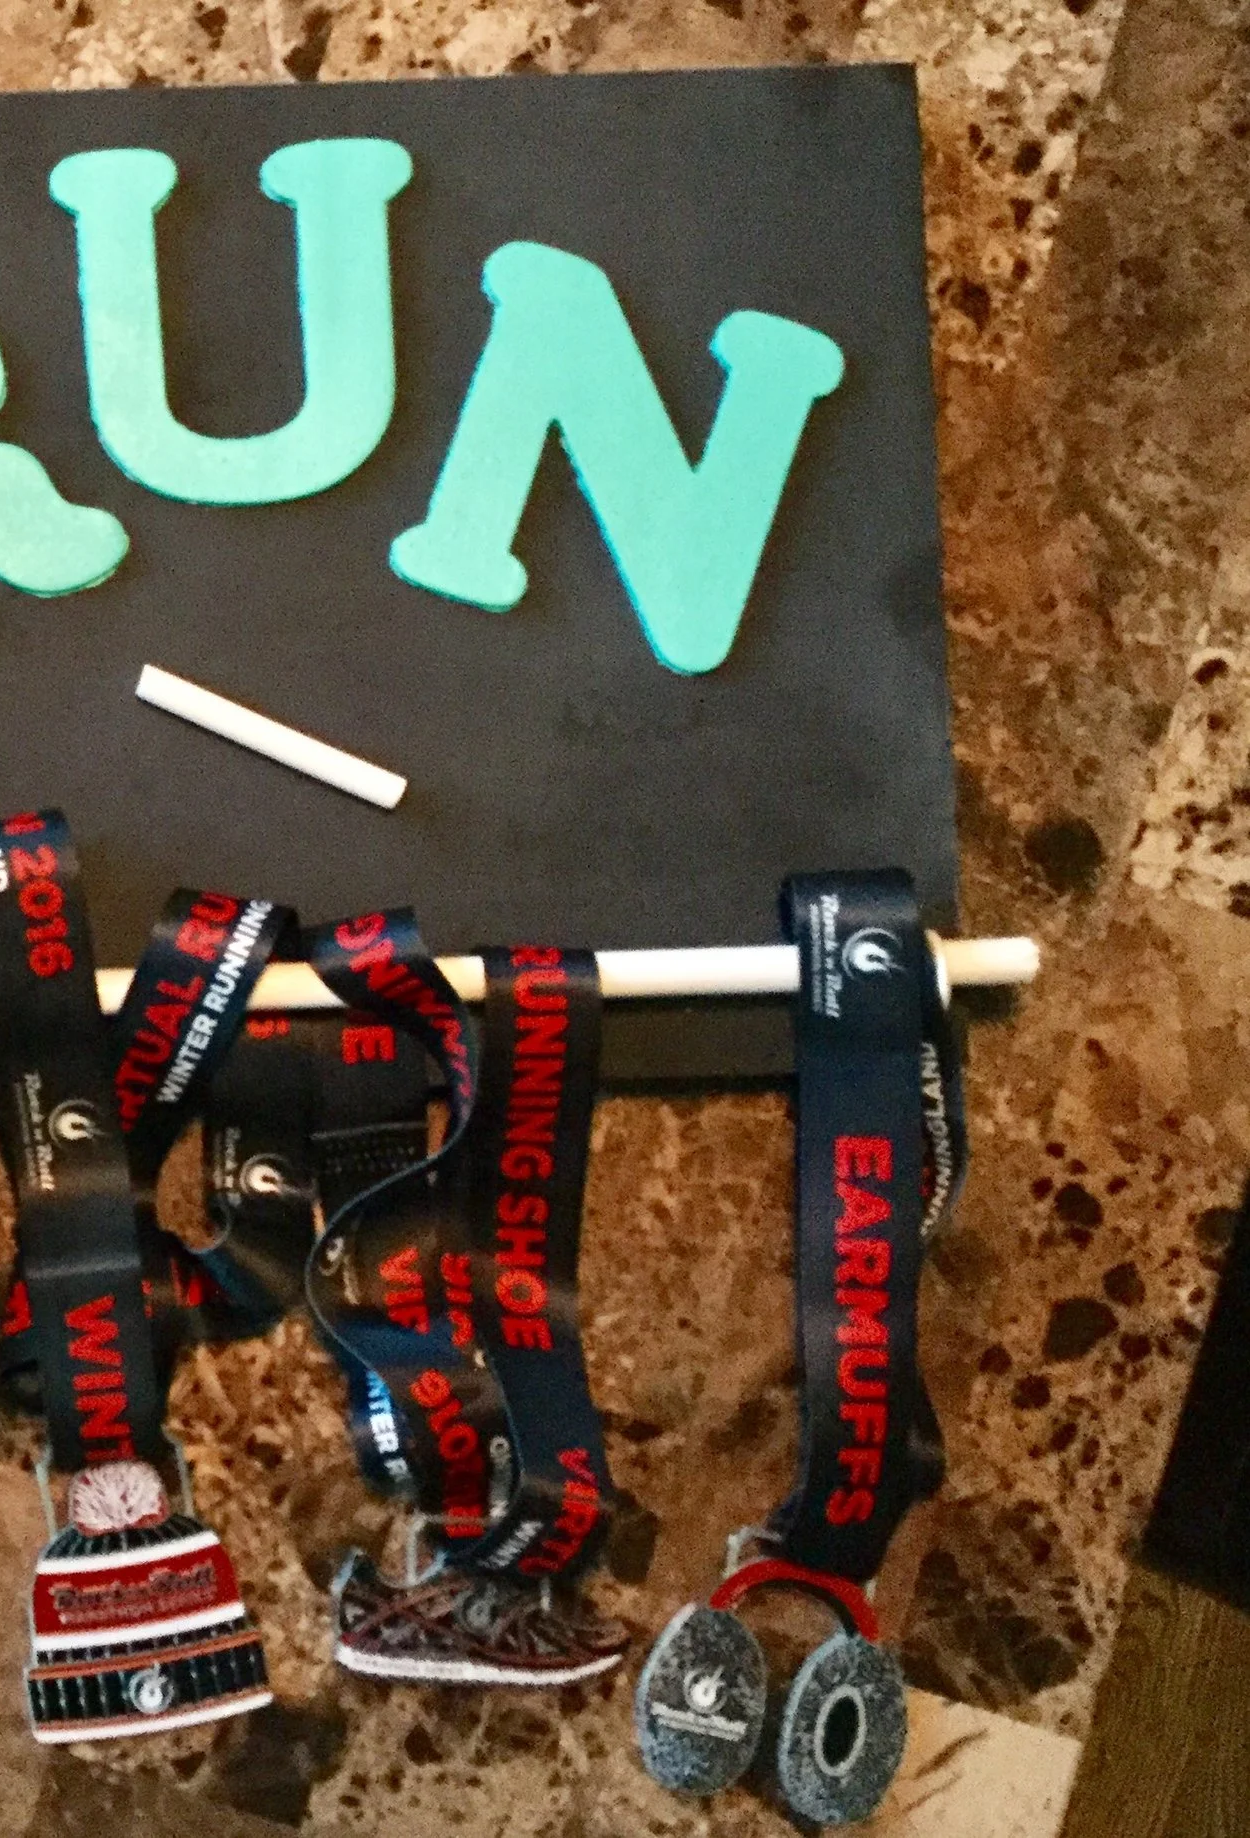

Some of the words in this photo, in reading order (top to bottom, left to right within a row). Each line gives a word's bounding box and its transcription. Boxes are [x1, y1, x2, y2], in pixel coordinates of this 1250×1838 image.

[7, 844, 76, 978] 2016
[155, 1014, 219, 1102] WINTER
[500, 943, 570, 1181] RUNNING
[494, 1192, 554, 1351] SHOE
[825, 1135, 894, 1527] EARMUFFS
[64, 1294, 139, 1461] WINT
